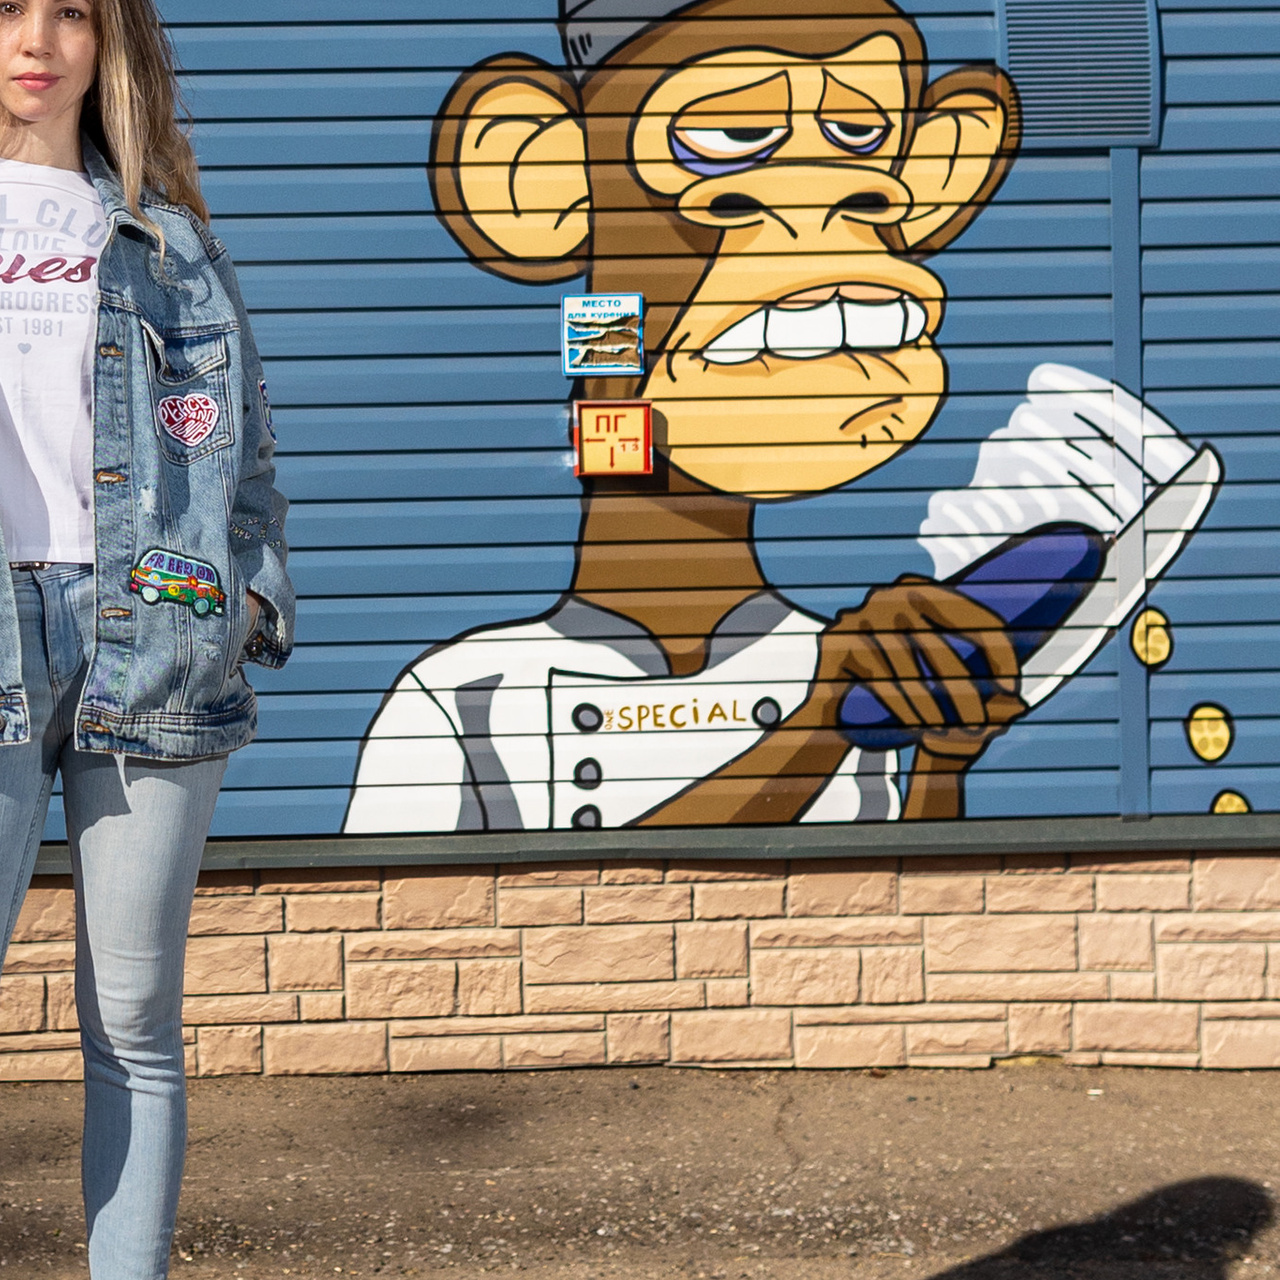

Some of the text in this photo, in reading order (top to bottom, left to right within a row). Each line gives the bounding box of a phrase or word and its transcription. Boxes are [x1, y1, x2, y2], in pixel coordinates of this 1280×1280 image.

[36, 198, 106, 248] CLU
[582, 300, 621, 308] МЕСТО
[23, 318, 63, 337] 1981
[596, 415, 626, 433] ПГ
